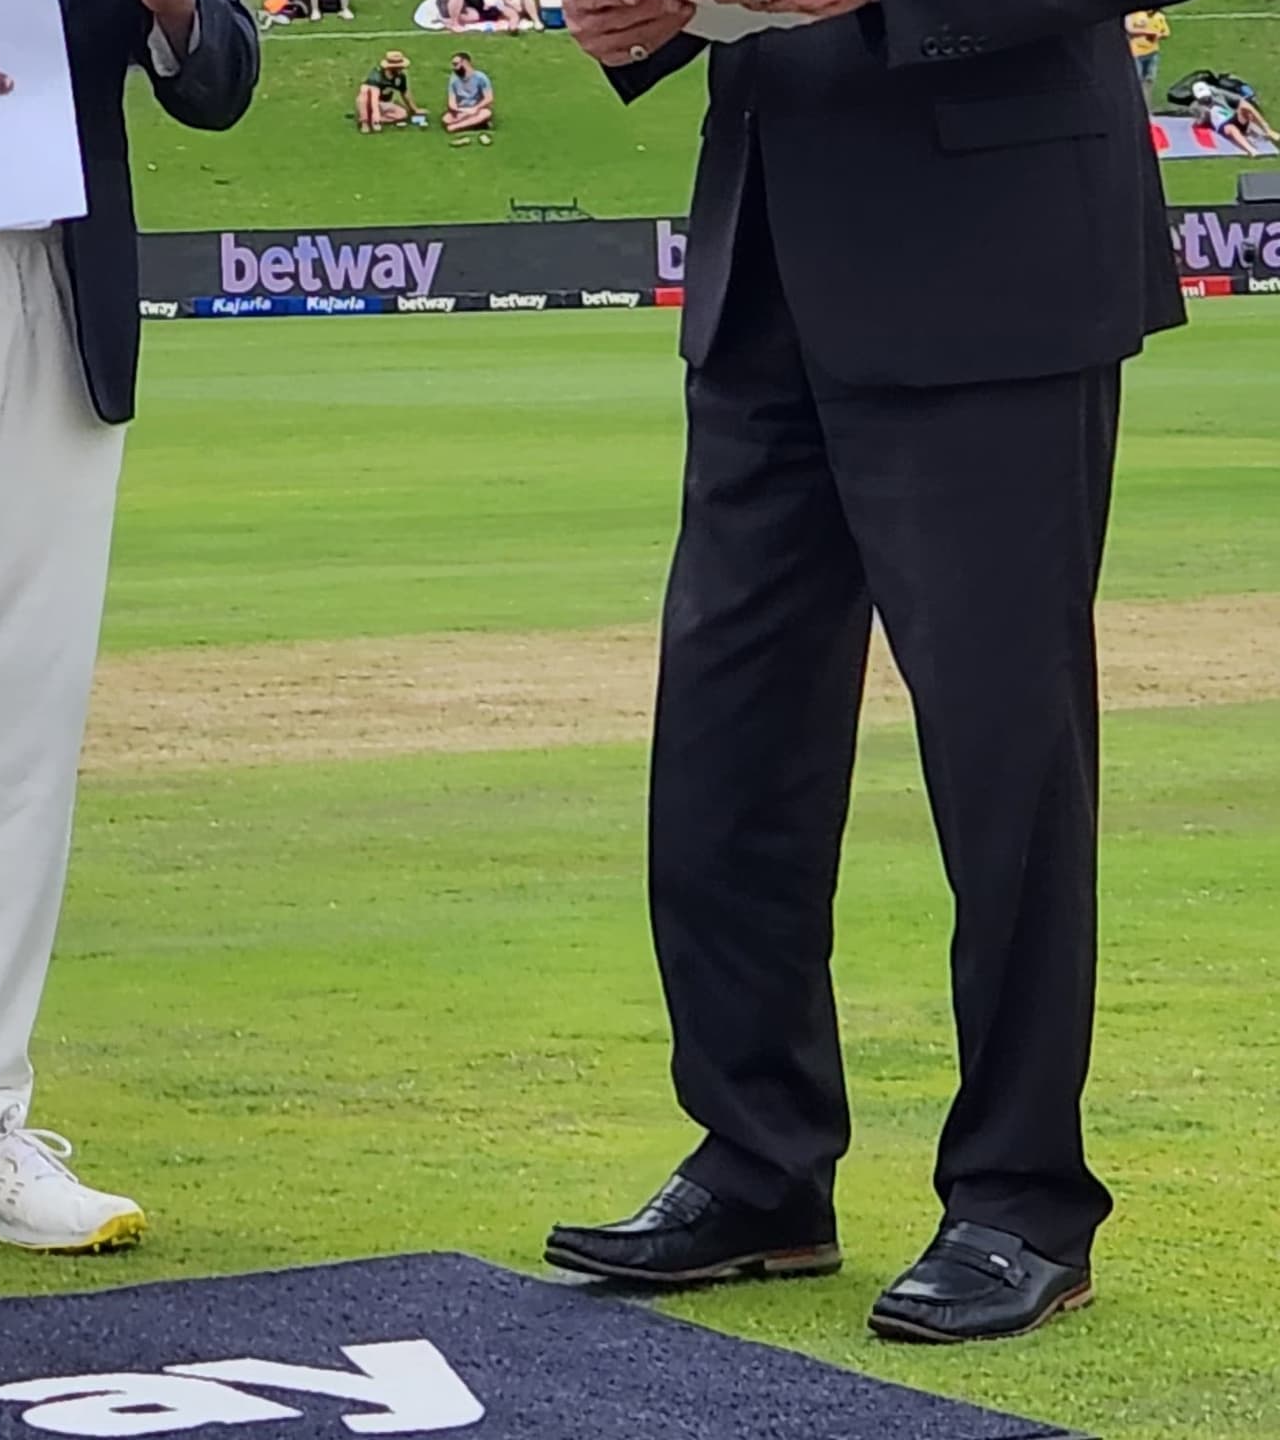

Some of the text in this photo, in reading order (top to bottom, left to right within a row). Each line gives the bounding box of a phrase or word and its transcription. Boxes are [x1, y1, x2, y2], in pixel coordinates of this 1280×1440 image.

[221, 233, 443, 297] betway
[212, 297, 273, 314] Kajaria
[306, 296, 365, 314] Kajaria
[397, 295, 456, 312] betway
[490, 292, 547, 310] betway
[581, 291, 640, 308] betway
[139, 300, 179, 318] tway
